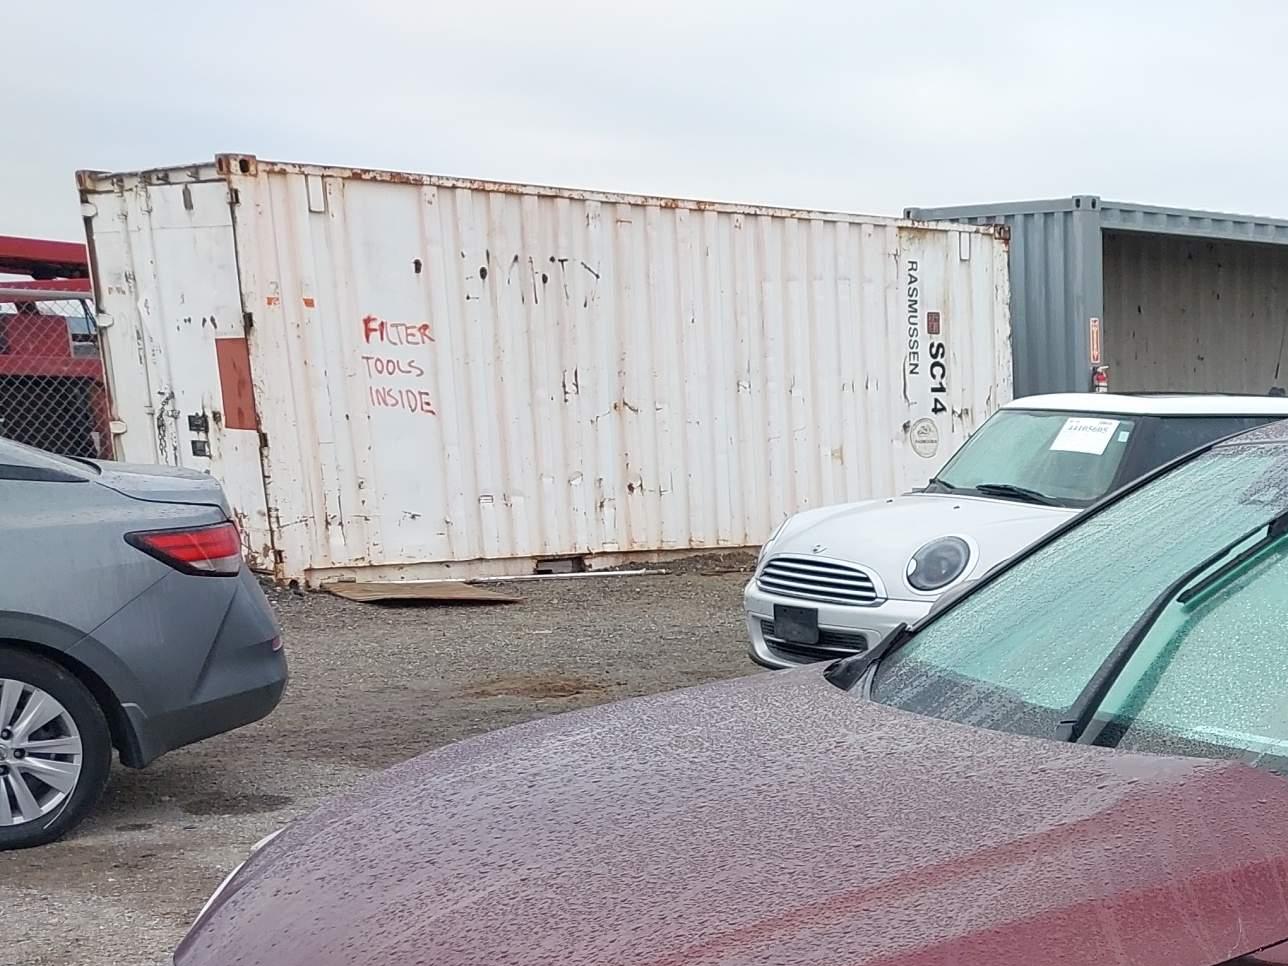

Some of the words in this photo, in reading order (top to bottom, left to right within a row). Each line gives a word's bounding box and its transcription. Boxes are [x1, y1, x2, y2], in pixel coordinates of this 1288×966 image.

[363, 316, 435, 345] FILTER
[907, 260, 919, 375] RASMUSSEN
[361, 356, 424, 378] TOOLS
[929, 341, 947, 415] SC14
[369, 386, 436, 415] INSIDE
